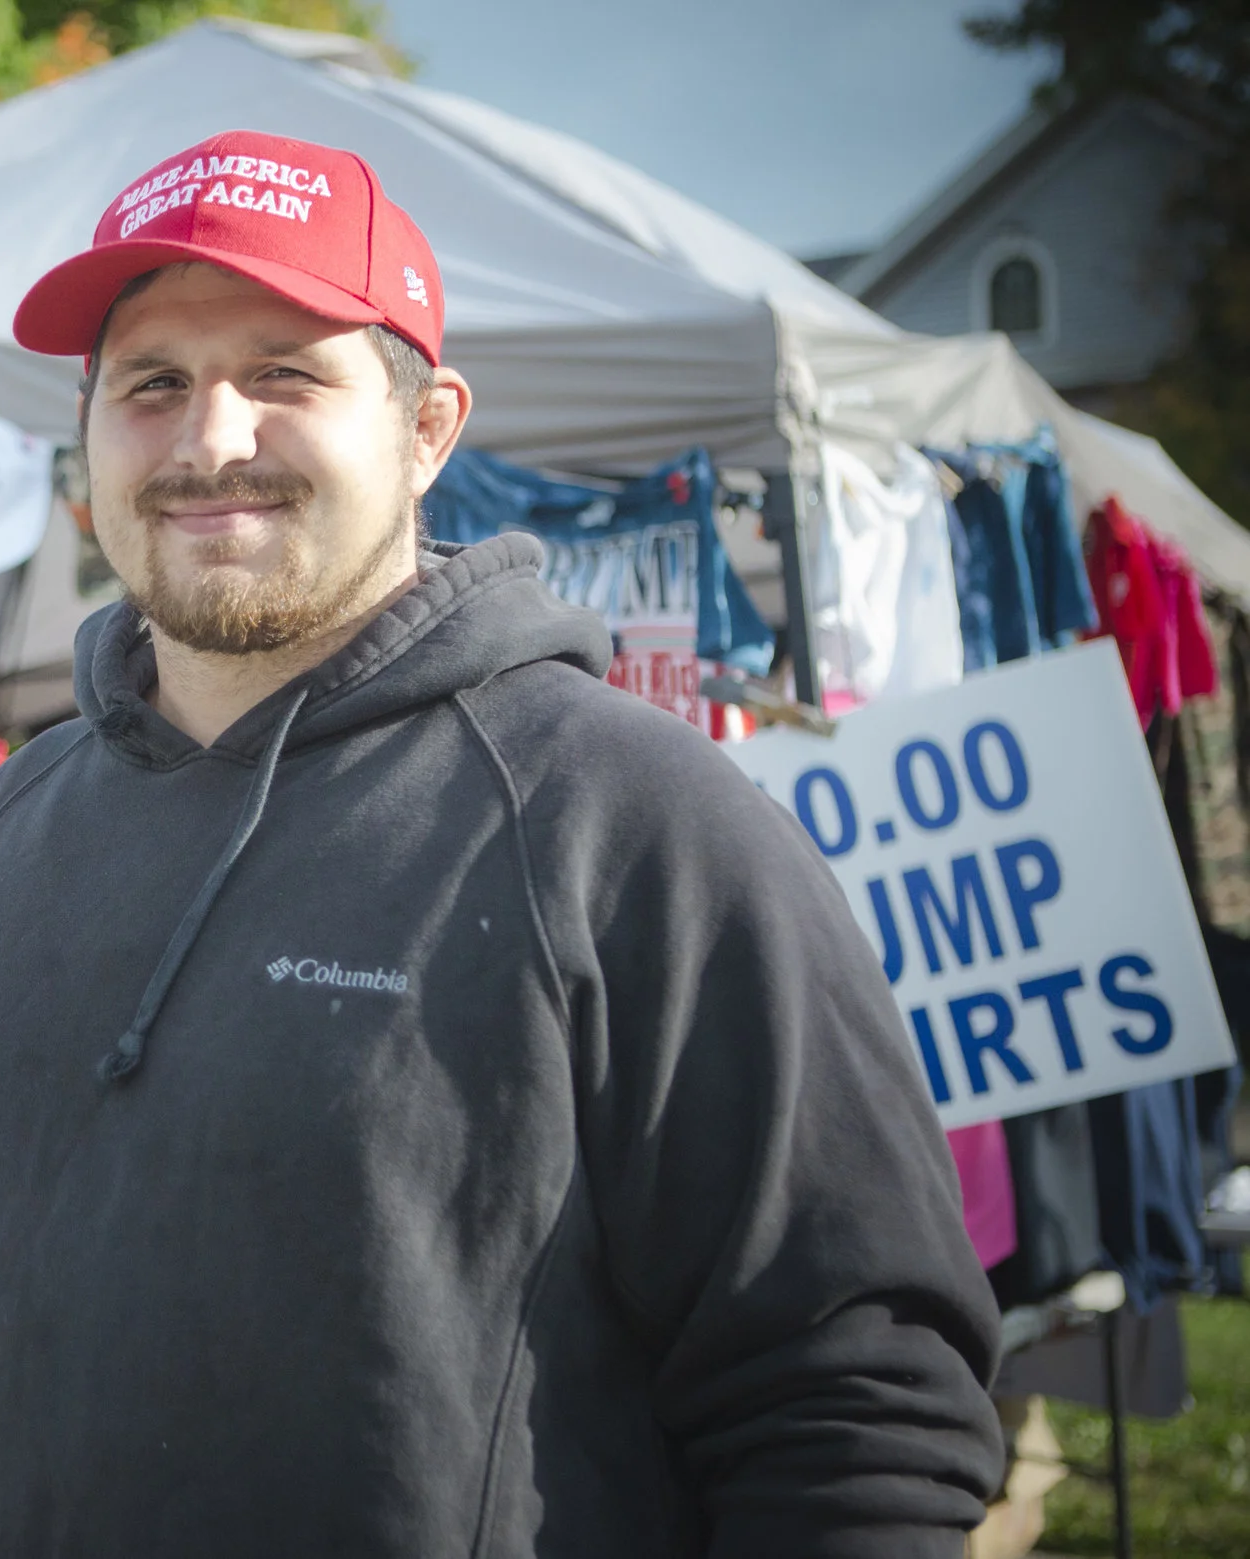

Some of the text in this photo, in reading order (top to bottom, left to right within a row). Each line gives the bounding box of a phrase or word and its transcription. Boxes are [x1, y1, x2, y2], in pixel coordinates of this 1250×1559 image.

[116, 155, 332, 216] MAKE AMERICA
[120, 181, 313, 239] GREAT AGAIN
[760, 719, 1031, 858] 0.00
[295, 958, 408, 991] Columbia
